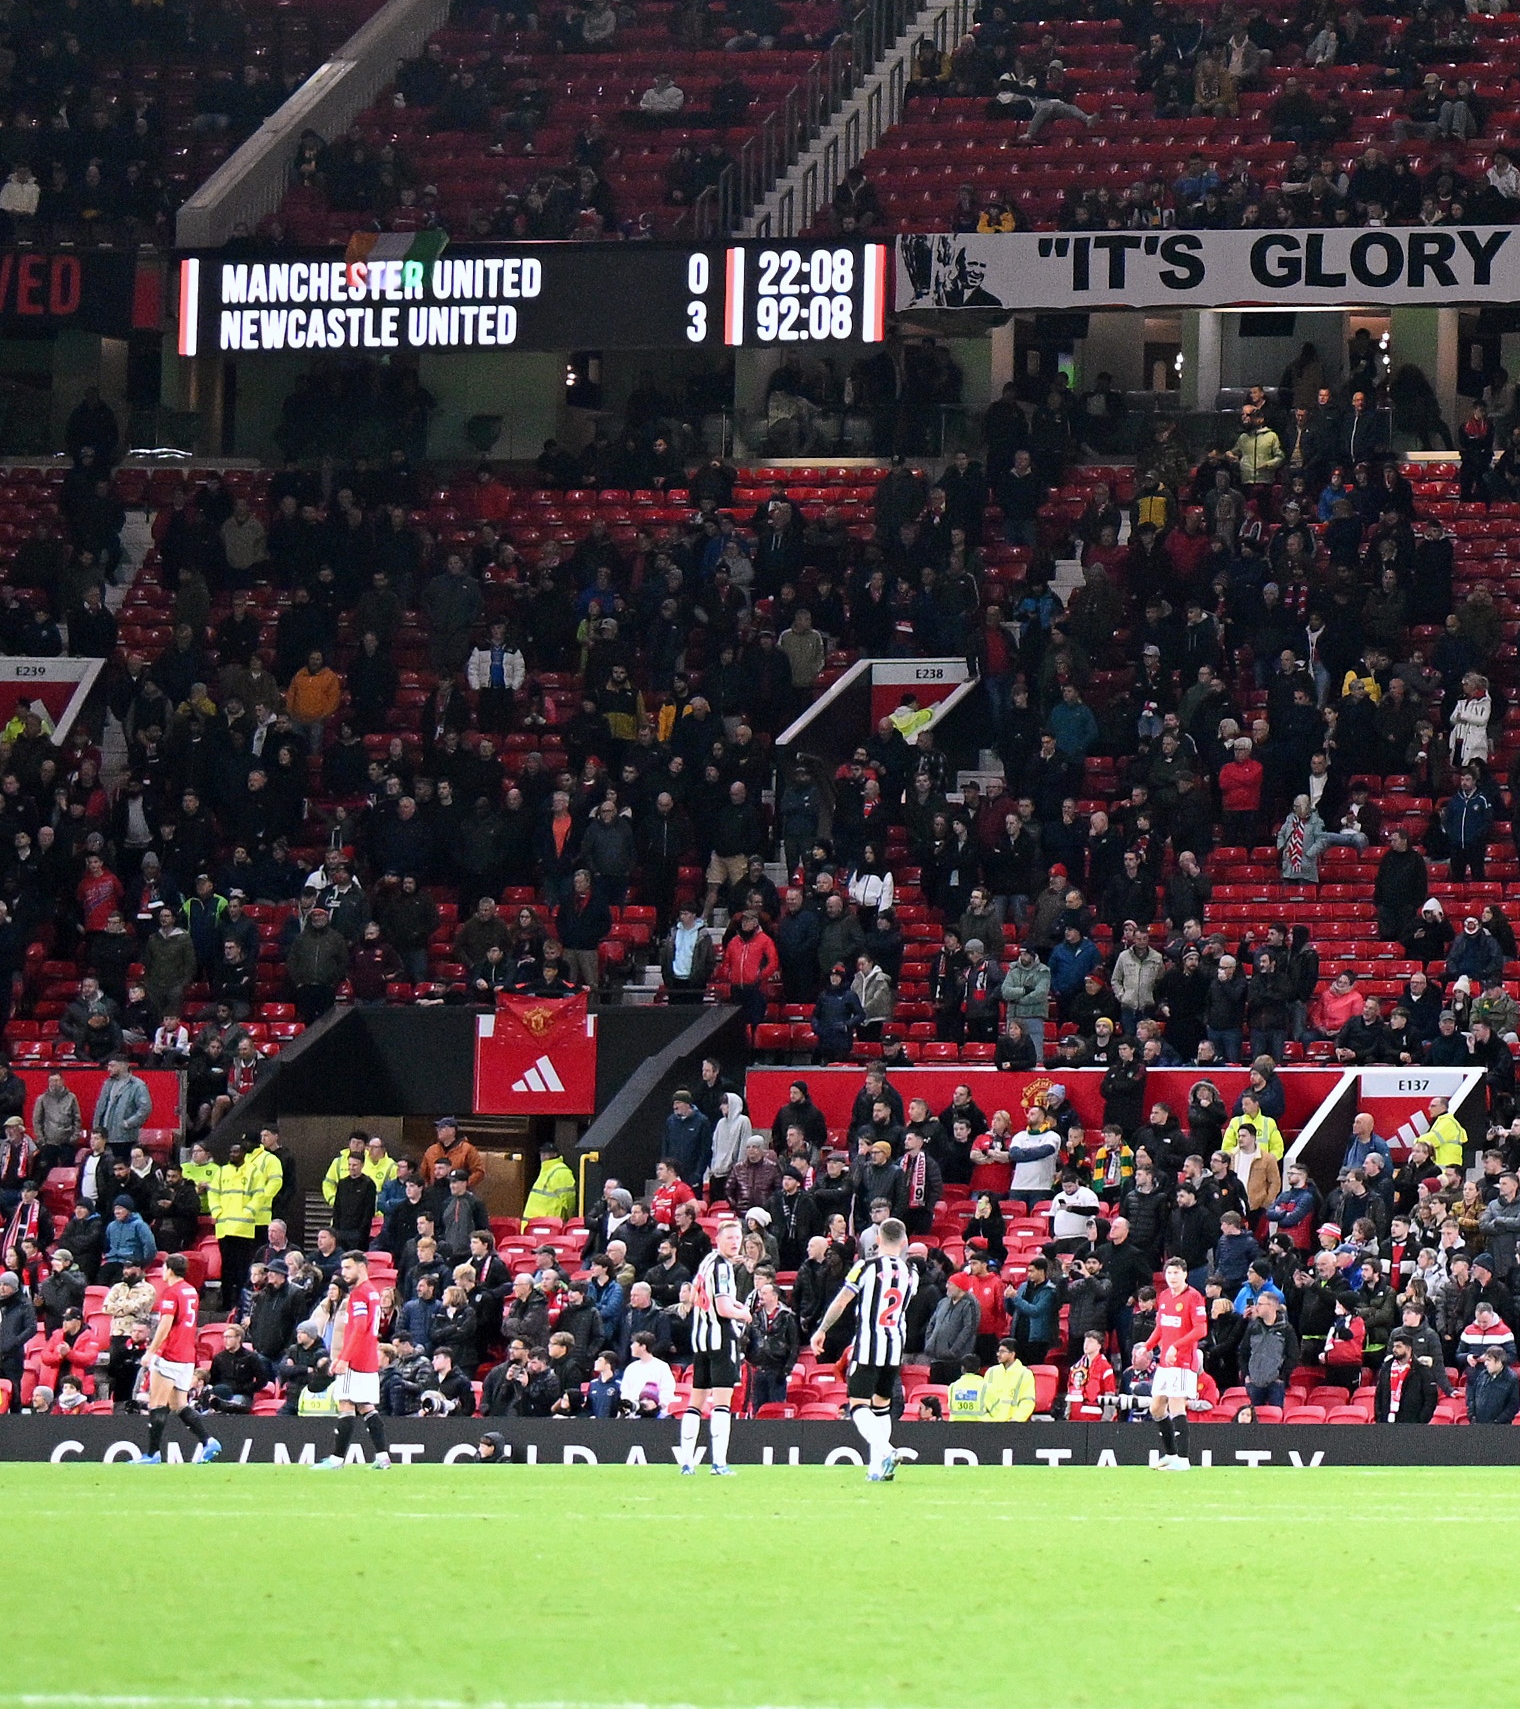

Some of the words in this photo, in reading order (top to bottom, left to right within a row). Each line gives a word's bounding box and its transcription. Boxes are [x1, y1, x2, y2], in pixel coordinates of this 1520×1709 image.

[222, 258, 424, 304] MANCHESTER
[433, 257, 541, 299] UNITED
[687, 252, 708, 295] 0
[757, 250, 854, 295] 22:08
[1038, 234, 1205, 291] "IT'S
[1250, 231, 1512, 288] GLORY
[220, 305, 399, 350] NEWCASTLE
[408, 301, 518, 346] UNITED
[686, 300, 708, 344] 3
[756, 297, 853, 342] 92:08
[16, 666, 46, 676] E239
[916, 669, 943, 679] E238
[1398, 1080, 1430, 1091] E137
[185, 1298, 196, 1327] 5
[879, 1287, 903, 1326] 2
[957, 1401, 974, 1410] 308
